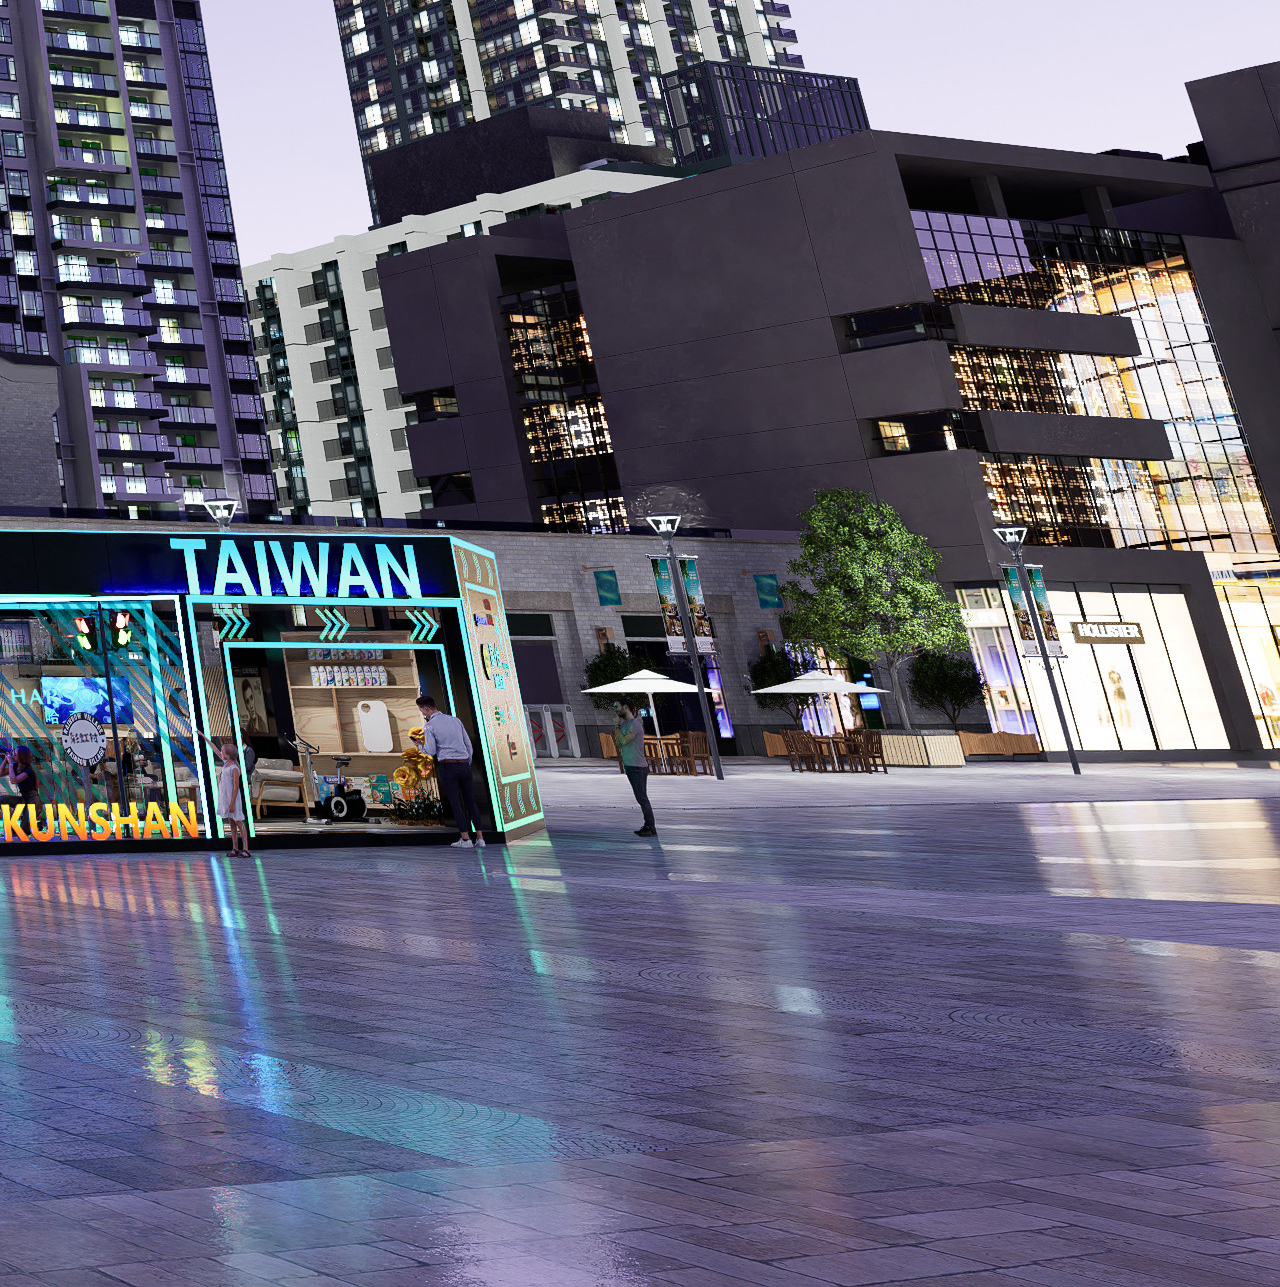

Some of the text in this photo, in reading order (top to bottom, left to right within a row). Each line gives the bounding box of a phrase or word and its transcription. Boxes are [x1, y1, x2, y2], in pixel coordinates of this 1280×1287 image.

[170, 538, 421, 598] TAIWAN
[1077, 623, 1142, 638] HOLLISTER
[1, 800, 200, 842] KUNSHAN
